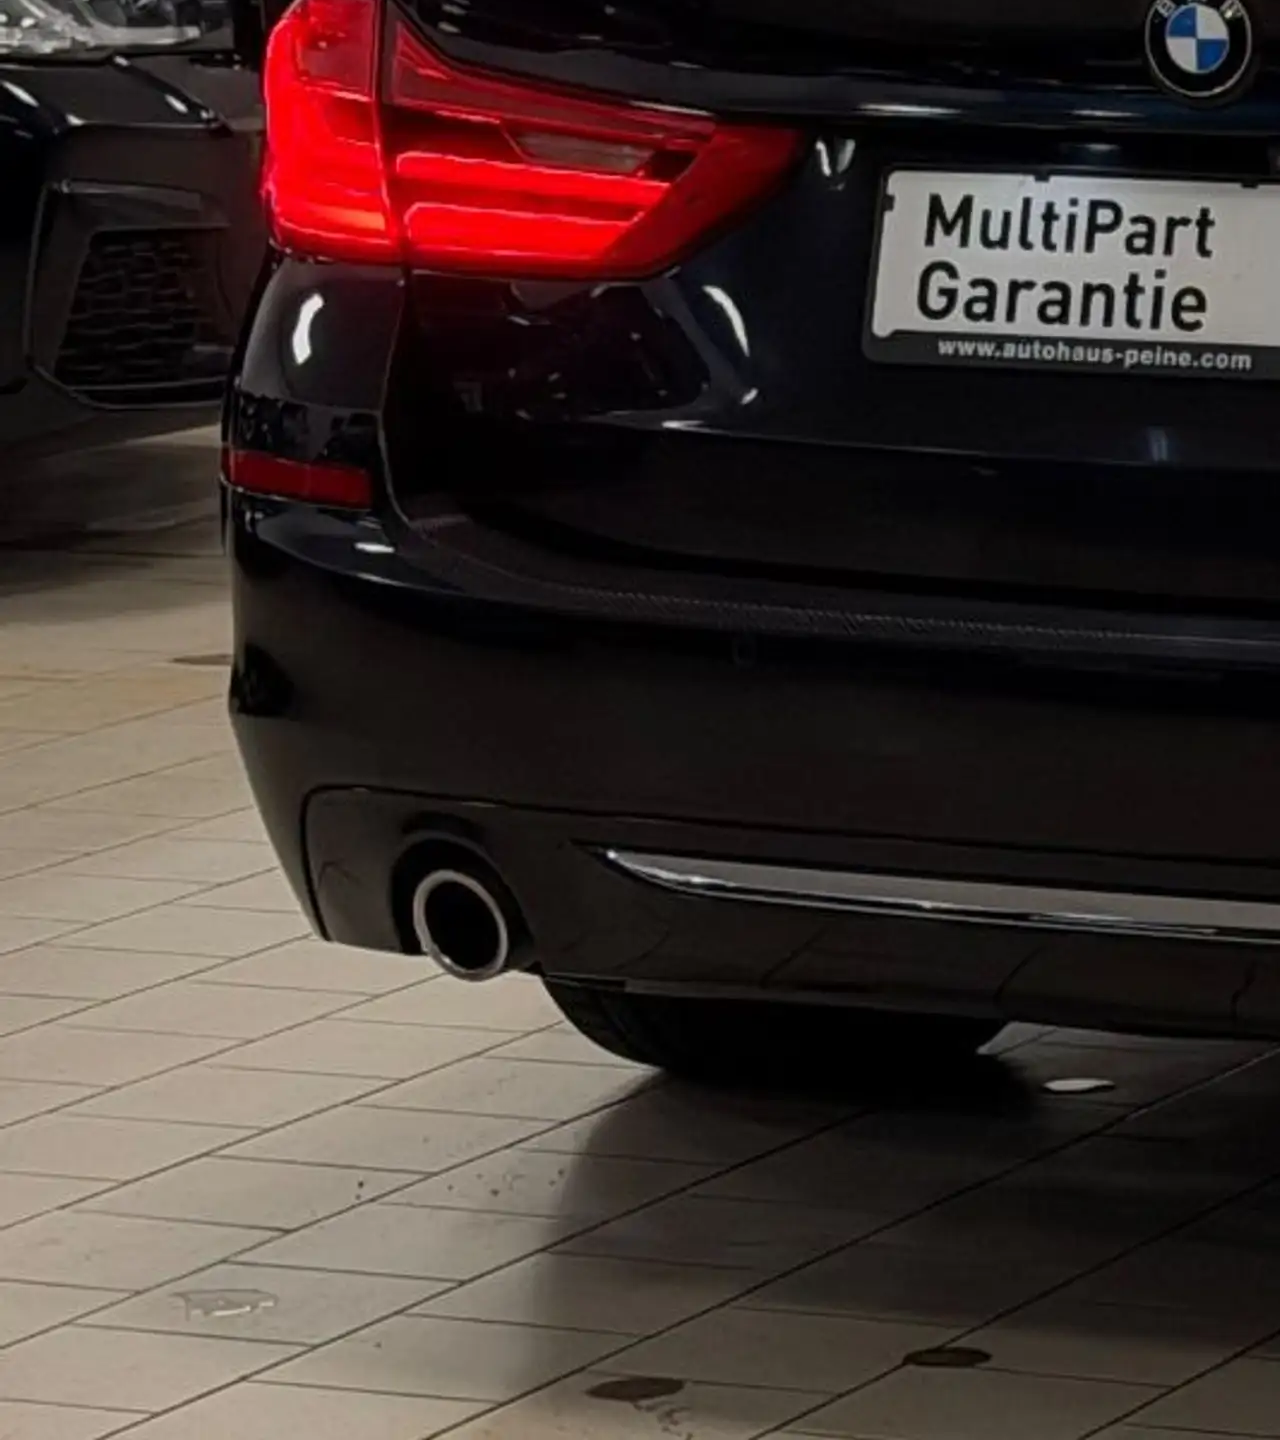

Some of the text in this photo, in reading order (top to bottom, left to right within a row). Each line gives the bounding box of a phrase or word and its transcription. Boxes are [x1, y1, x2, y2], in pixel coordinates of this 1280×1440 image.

[923, 192, 1216, 258] MultiPart
[916, 260, 1208, 332] Garantie
[938, 337, 1253, 371] www.autohaus-peine.com
